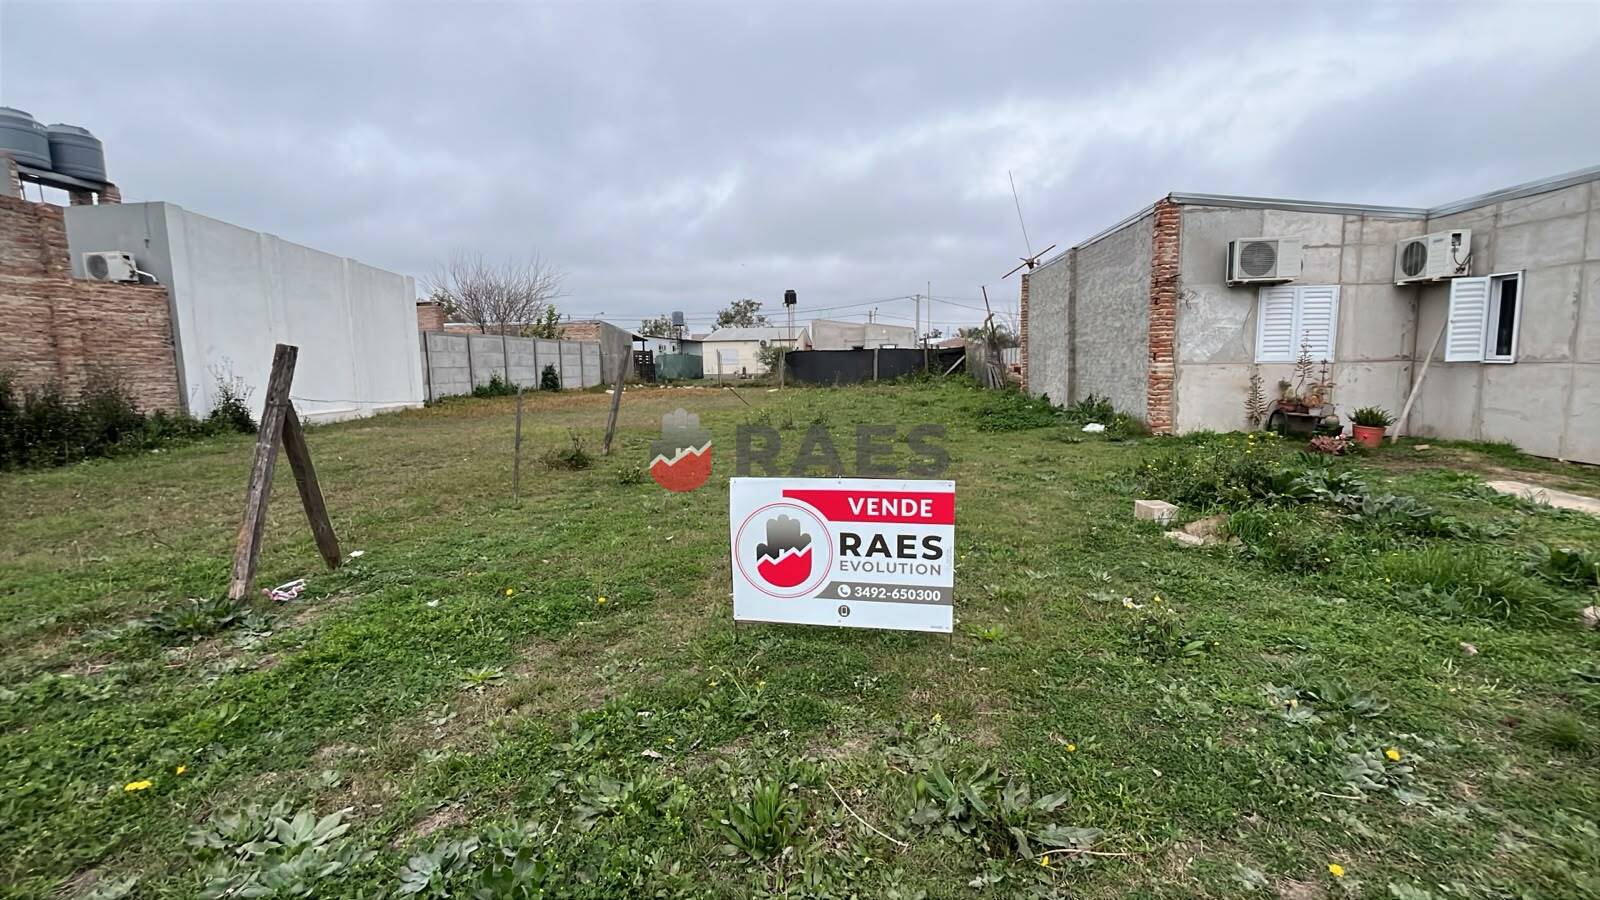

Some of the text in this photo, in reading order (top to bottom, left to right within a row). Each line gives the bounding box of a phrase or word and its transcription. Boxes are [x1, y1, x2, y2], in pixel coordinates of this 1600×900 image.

[847, 497, 934, 518] VENDE
[839, 532, 944, 561] RAES
[840, 560, 942, 576] EVOLUTION
[854, 586, 942, 602] 3492-650300
